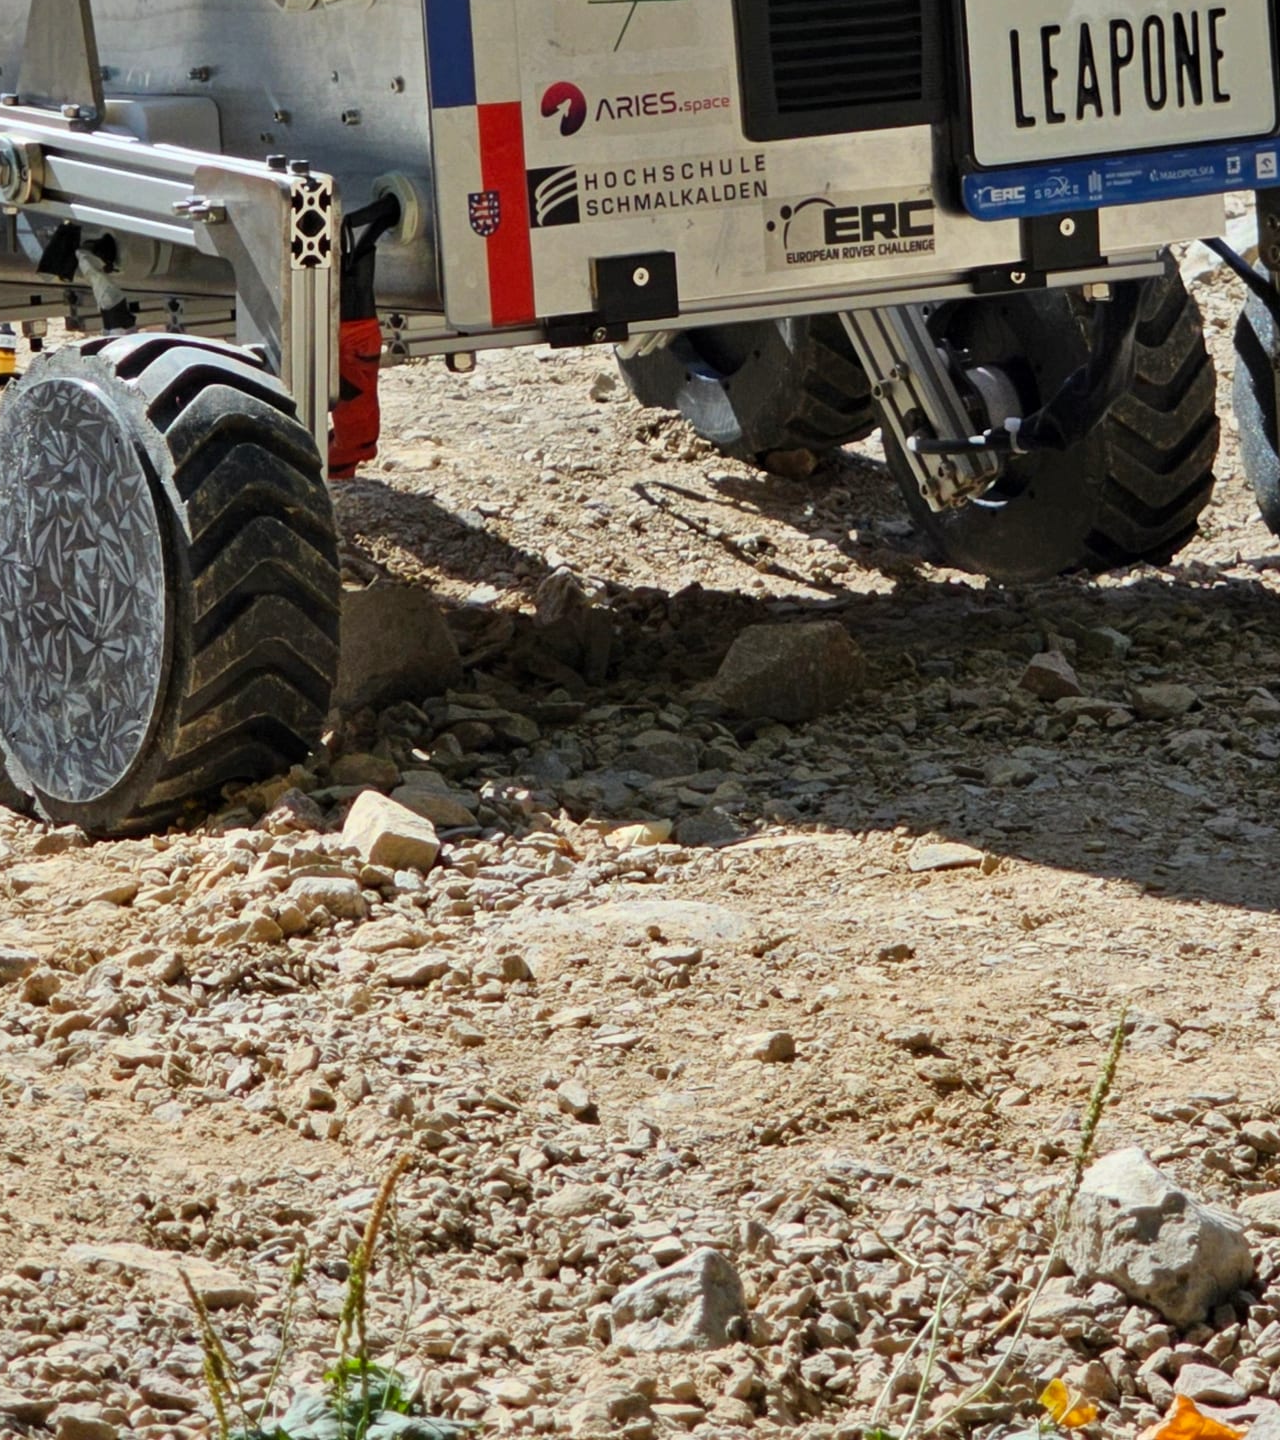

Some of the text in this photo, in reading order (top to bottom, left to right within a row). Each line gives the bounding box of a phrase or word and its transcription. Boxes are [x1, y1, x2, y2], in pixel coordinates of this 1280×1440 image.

[1009, 6, 1231, 129] LEAPONE
[584, 154, 767, 191] HOCHSCHULE
[586, 179, 769, 217] SCHMALKALDEN
[990, 185, 1026, 203] ERC
[823, 198, 935, 245] ERC
[786, 238, 935, 264] EUROPEAN ROVER CHALLENGE
